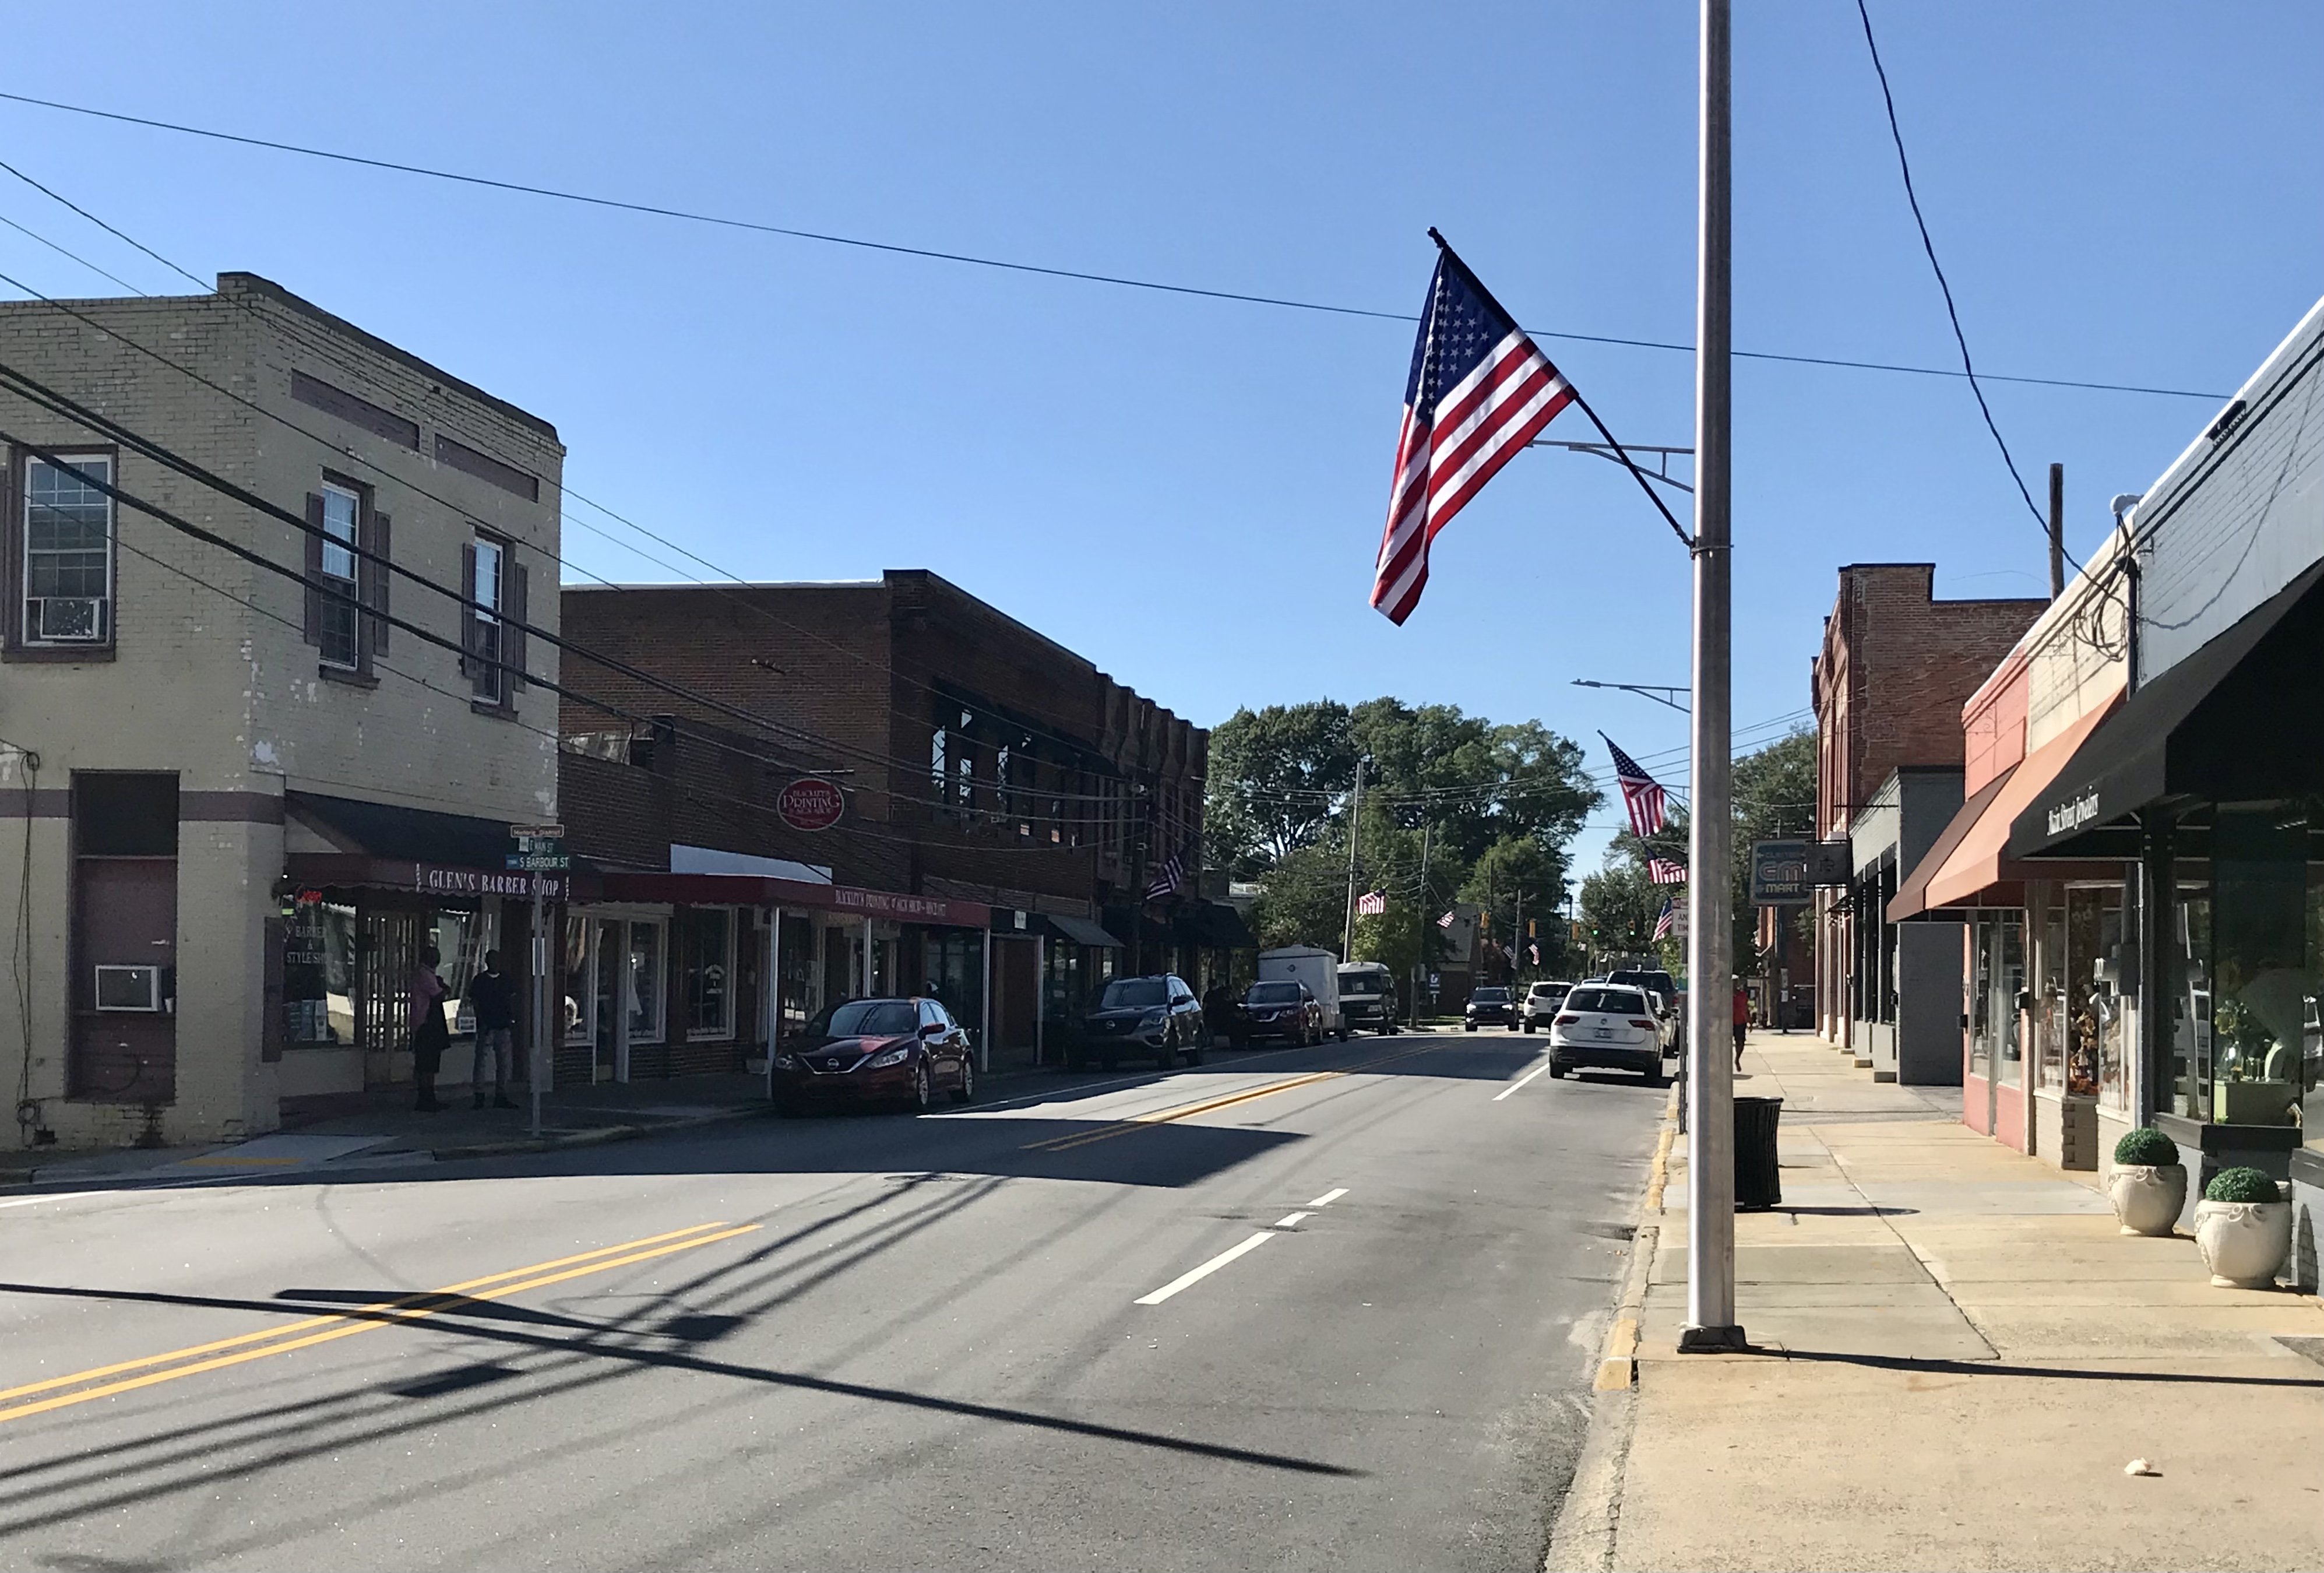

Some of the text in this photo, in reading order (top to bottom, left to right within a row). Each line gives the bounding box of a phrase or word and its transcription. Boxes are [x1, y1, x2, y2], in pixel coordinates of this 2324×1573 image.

[783, 794, 840, 808] PRINTING
[2060, 801, 2075, 831] Street
[530, 840, 534, 850] E
[519, 857, 524, 867] S
[526, 857, 558, 868] BARBOUR
[560, 857, 569, 868] ST
[429, 870, 475, 892] GLEN'S
[481, 874, 526, 895] BARBER
[1765, 883, 1800, 893] MART
[286, 951, 311, 964] STYLE
